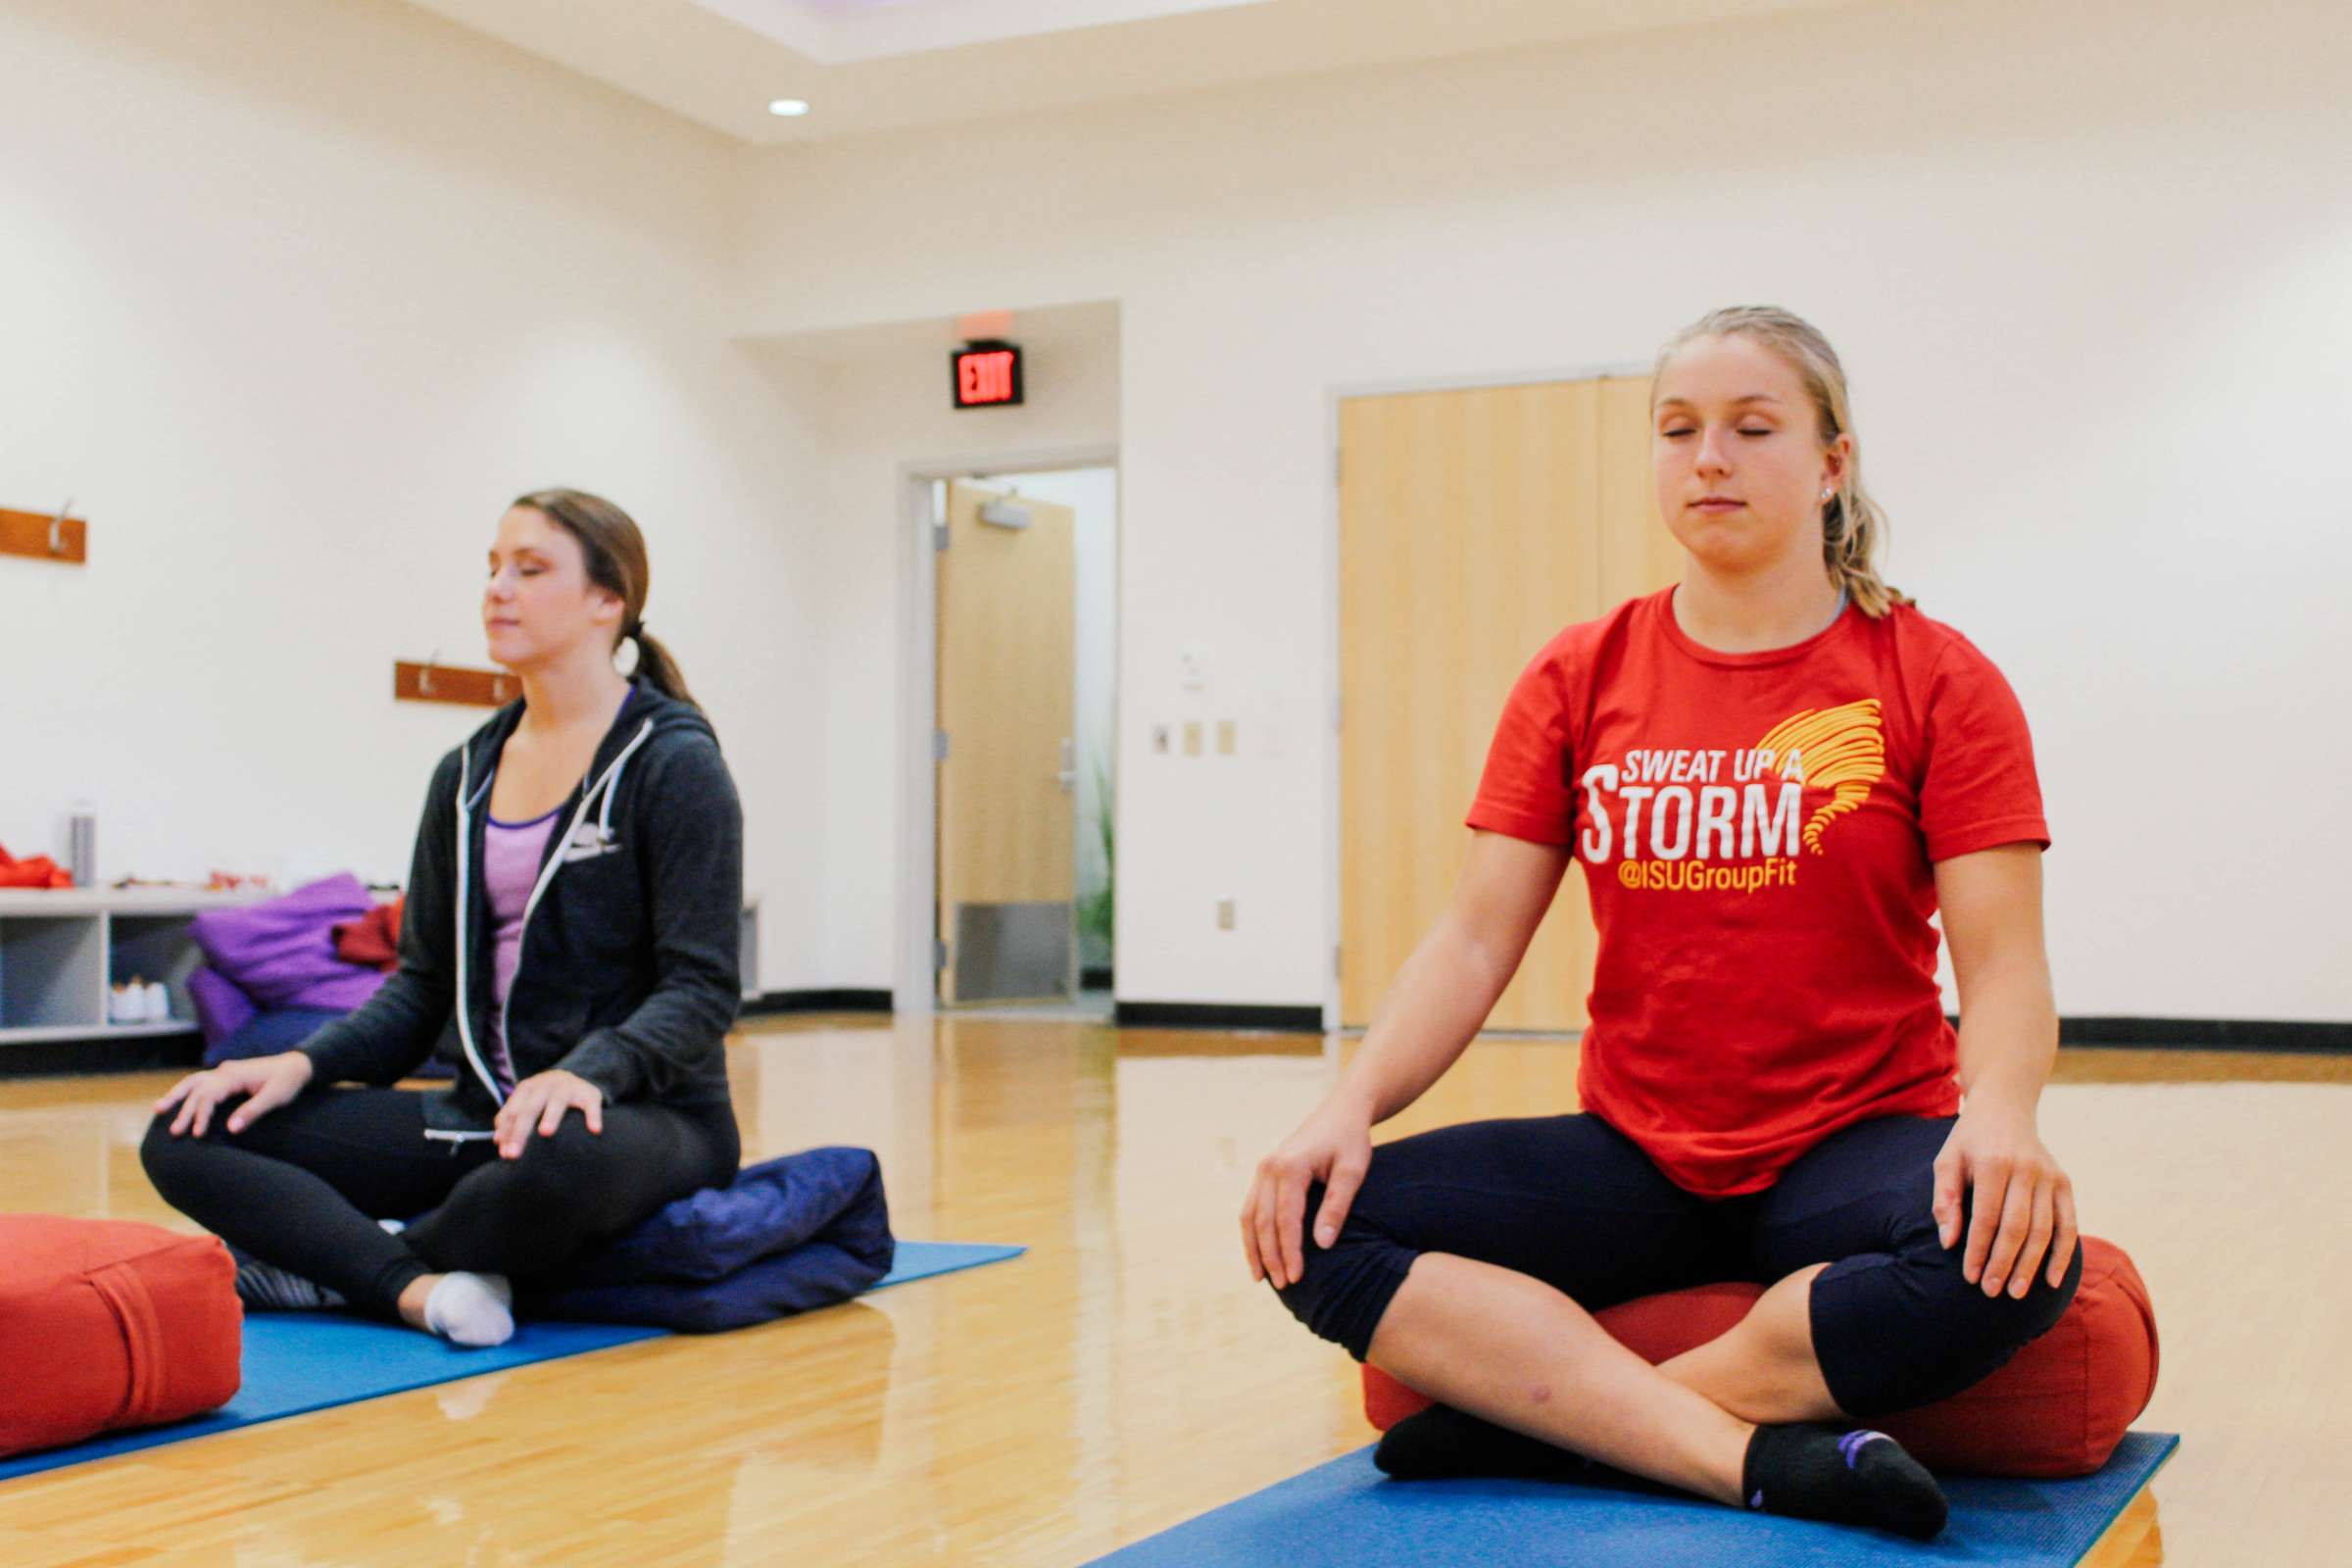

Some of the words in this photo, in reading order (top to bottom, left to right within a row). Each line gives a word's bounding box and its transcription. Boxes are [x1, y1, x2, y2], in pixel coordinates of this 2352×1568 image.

[1621, 749, 1726, 783] SWEAT
[1733, 749, 1776, 782] UP
[1782, 748, 1804, 781] A
[1582, 763, 1802, 863] STORM
[1618, 858, 1797, 894] @ISUGroupFit
